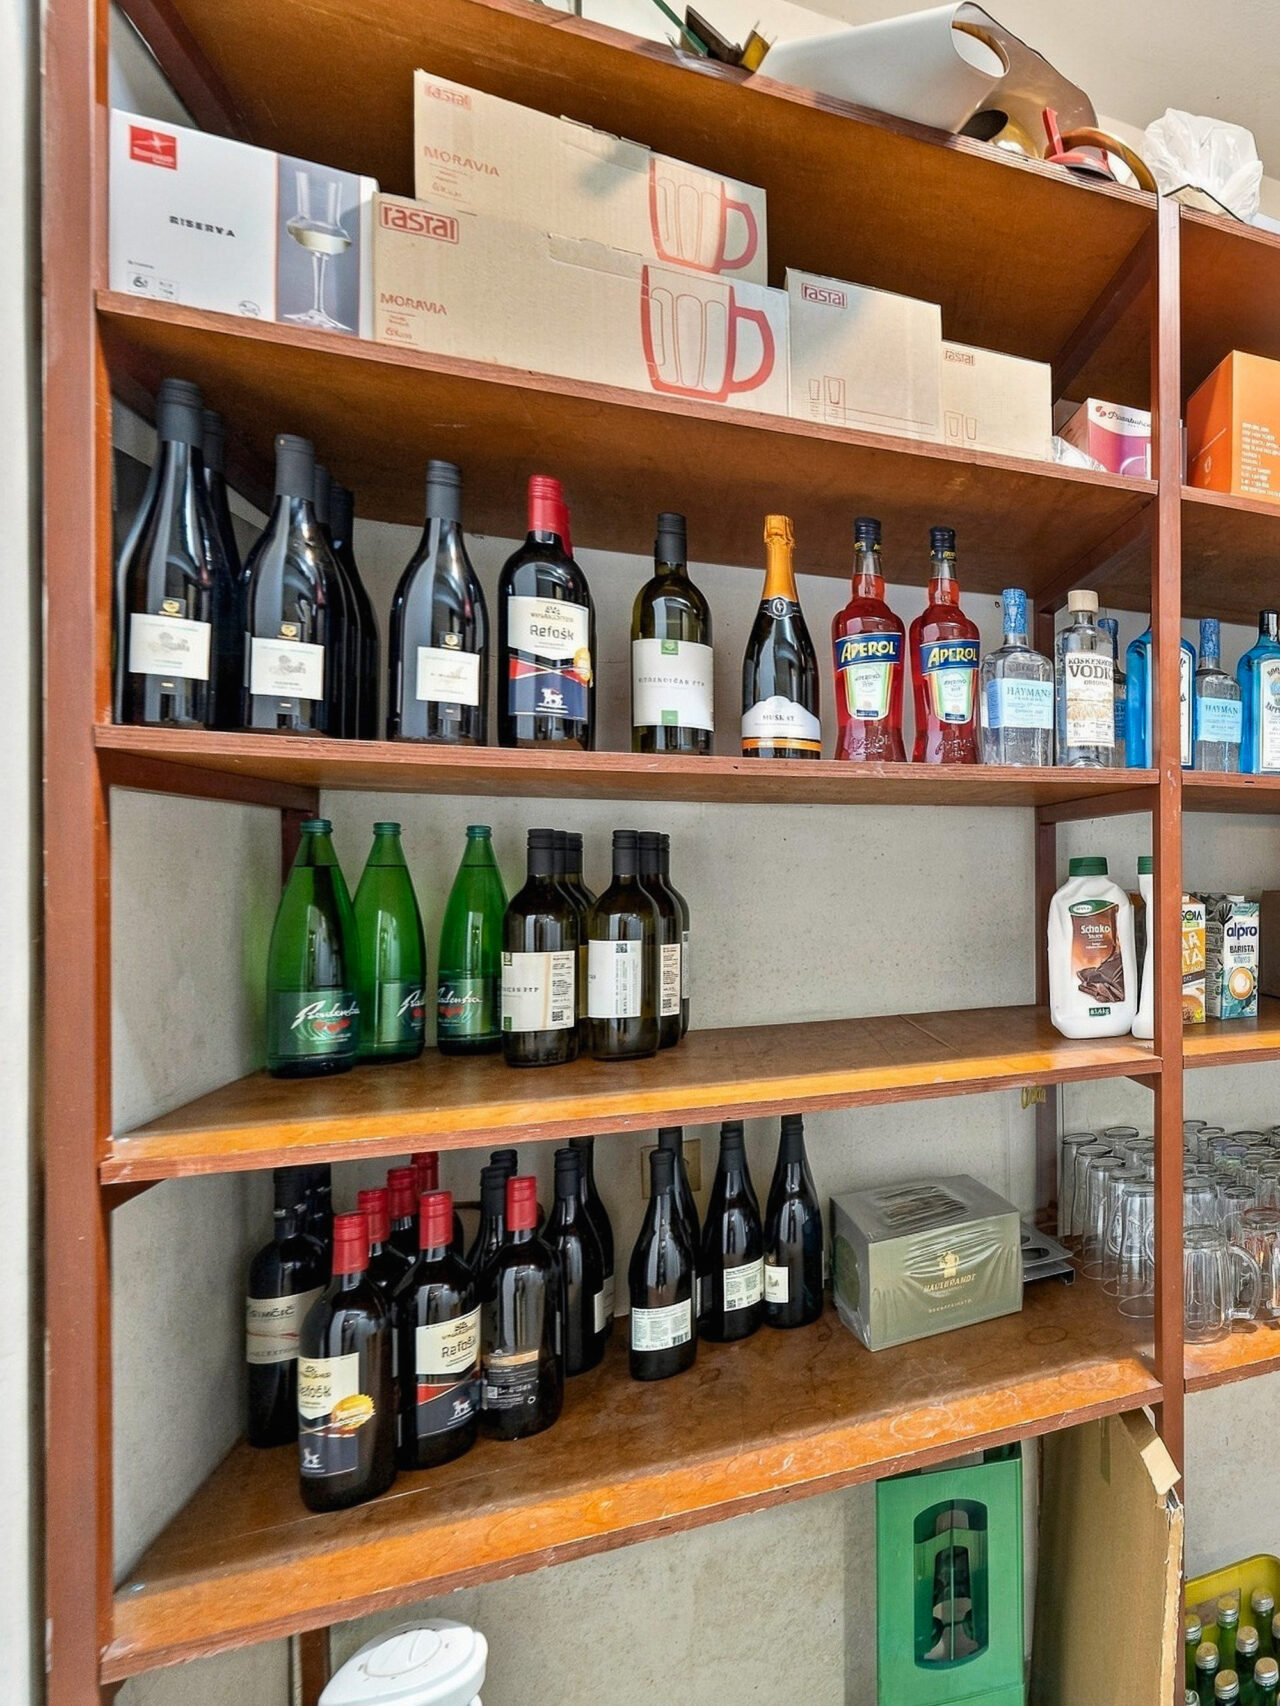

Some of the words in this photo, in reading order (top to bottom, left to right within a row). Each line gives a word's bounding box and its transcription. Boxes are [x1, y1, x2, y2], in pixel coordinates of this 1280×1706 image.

[423, 145, 500, 177] MORAVIA
[169, 215, 236, 238] RISERVA
[382, 205, 456, 241] rastal
[380, 292, 447, 315] MORAVIA
[803, 285, 845, 307] rastal
[944, 350, 974, 365] rastal
[841, 640, 896, 663] APEROL
[927, 647, 978, 668] APEROL
[1068, 664, 1114, 680] VODK
[1080, 924, 1111, 934] Schoko
[1226, 922, 1258, 940] alpro
[1229, 944, 1255, 954] BARISTA
